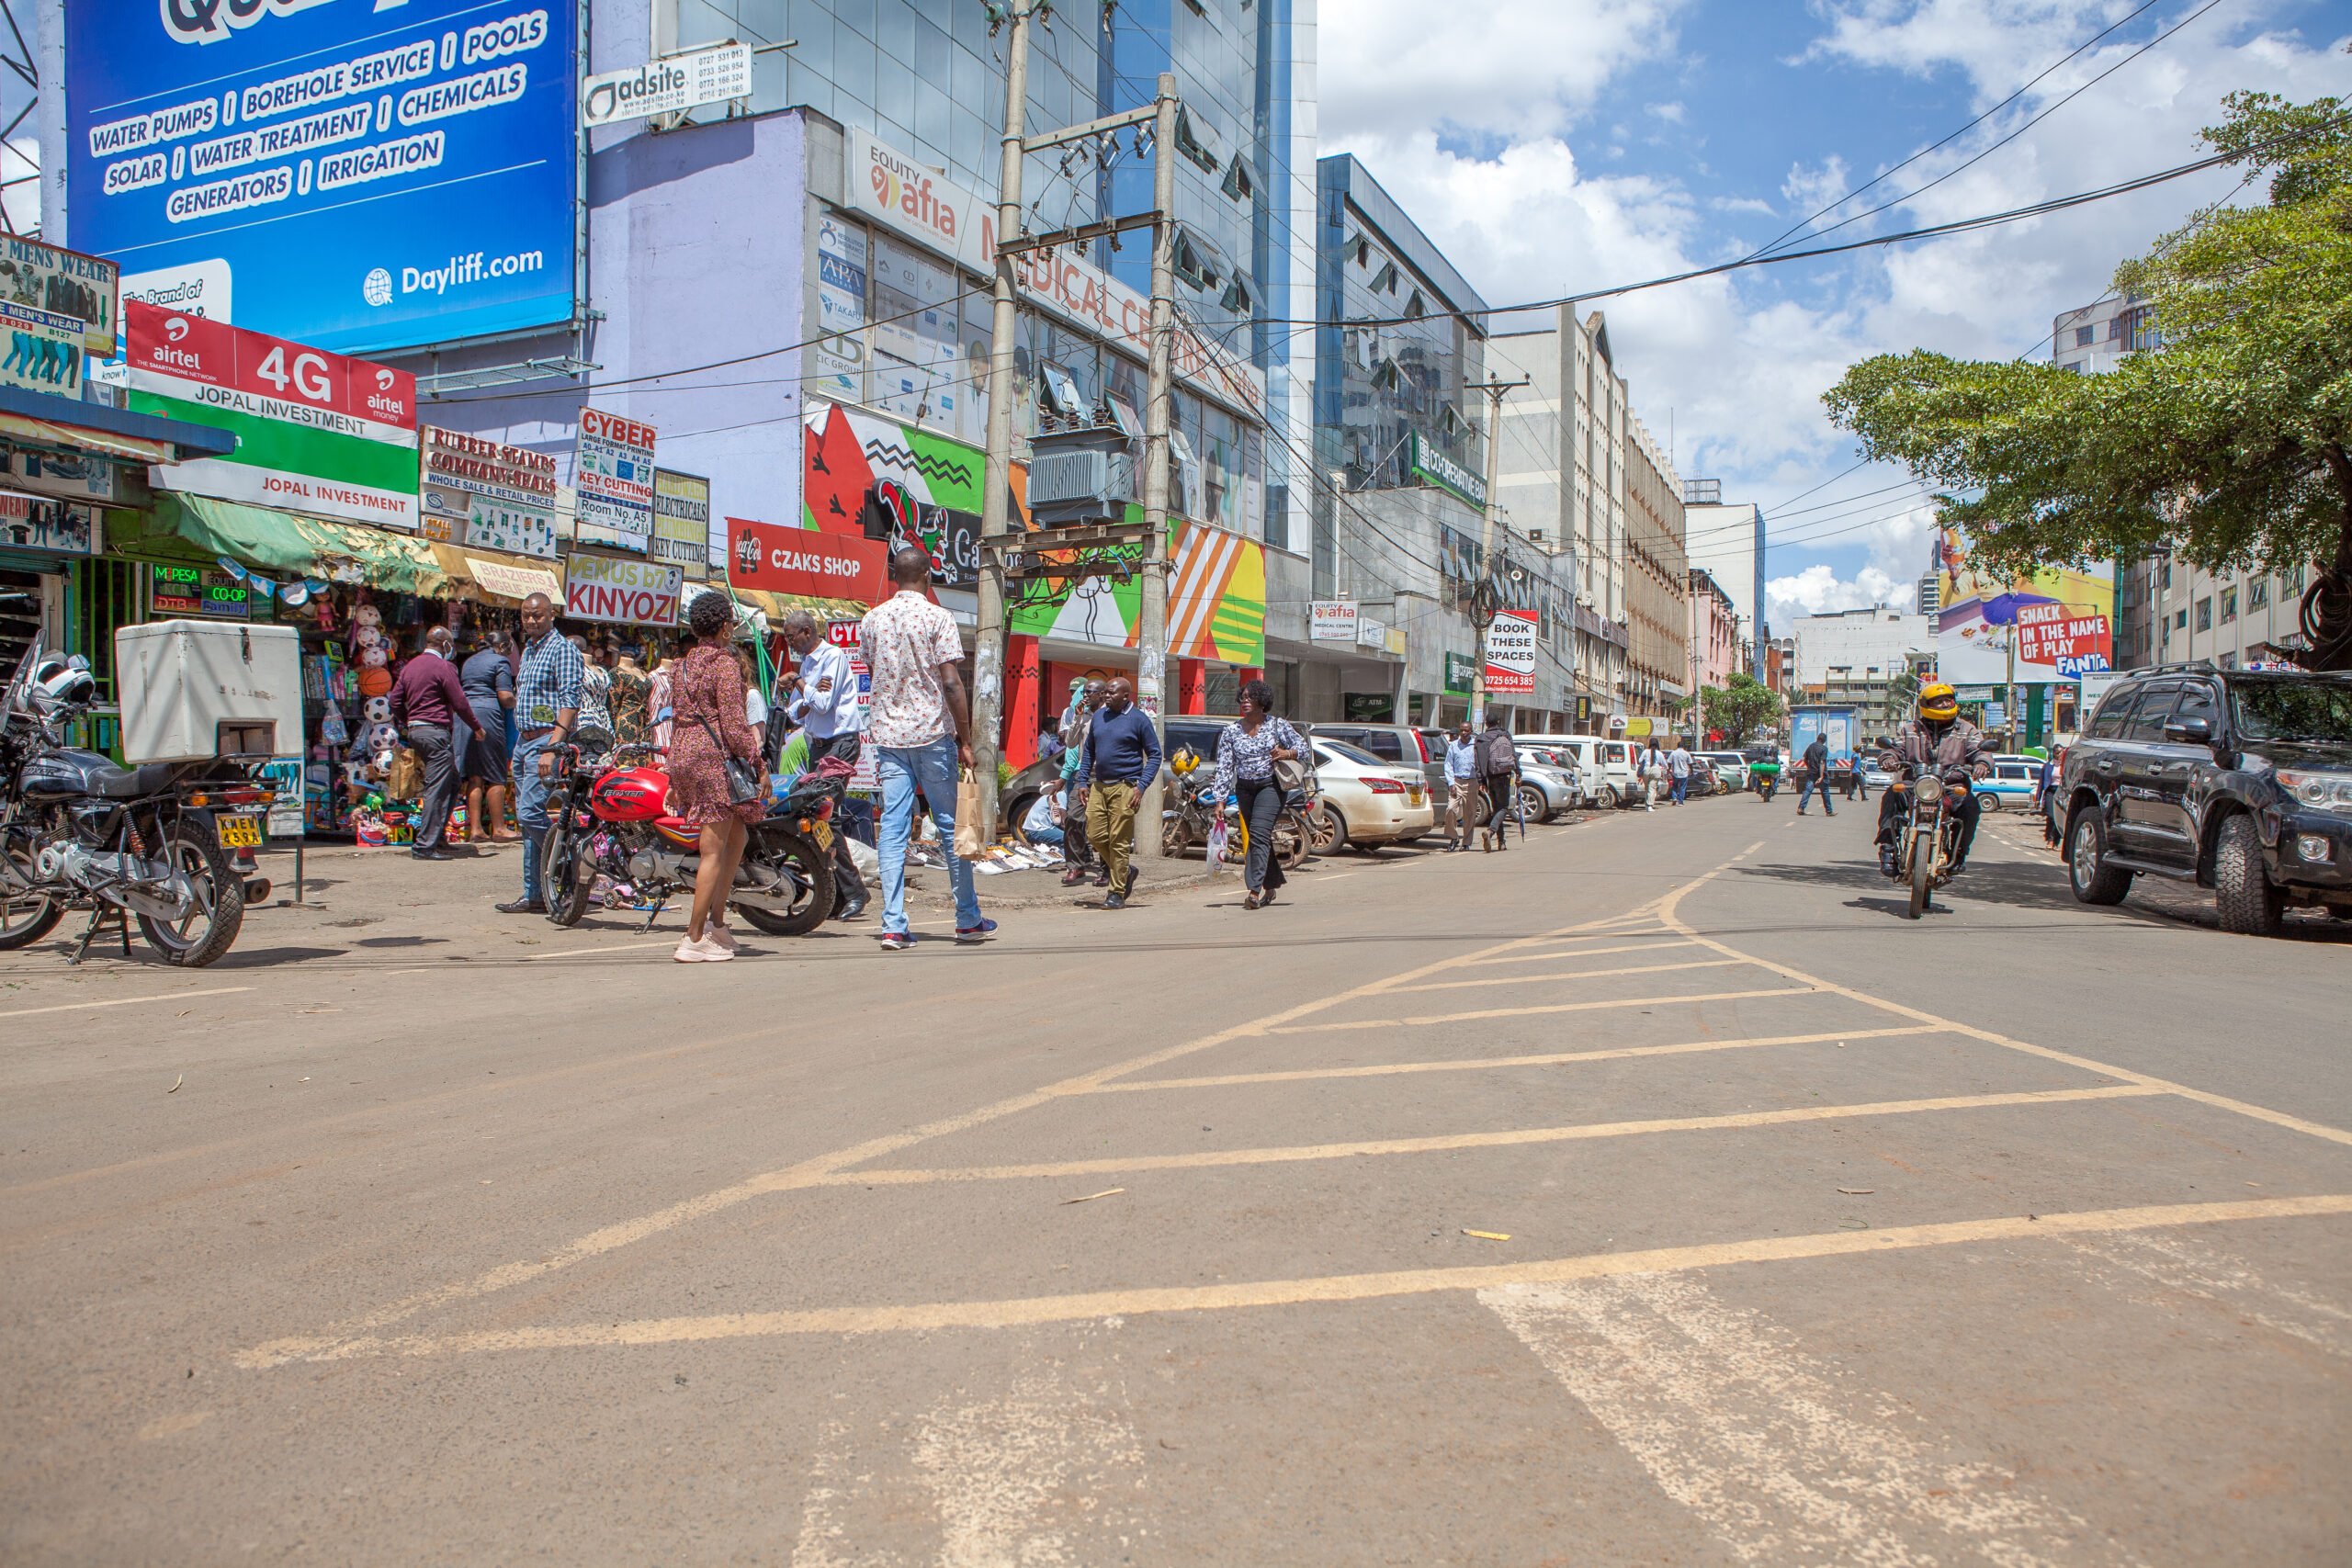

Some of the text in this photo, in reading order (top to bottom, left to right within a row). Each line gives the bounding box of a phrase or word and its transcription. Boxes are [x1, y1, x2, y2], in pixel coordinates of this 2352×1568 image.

[698, 49, 743, 65] 0727 531 013
[698, 61, 743, 77] 0733 526 954
[93, 17, 541, 152] WATER PUMPS BOREHOLE SERVICE POOLS
[618, 63, 685, 101] adsite
[698, 73, 743, 88] 0772 166 324
[108, 70, 521, 188] SOLAR WATER TREATMENT CHEMICALS
[171, 137, 440, 216] GENERATORS IRRIGATION
[870, 145, 921, 186] EQUITY
[901, 178, 956, 239] afia
[9, 240, 54, 269] MENS
[60, 253, 109, 284] WEAR
[401, 250, 543, 295] Dayliff.com
[147, 282, 186, 305] Brand
[187, 278, 204, 299] of
[9, 305, 45, 322] MEN'S
[48, 315, 81, 332] WEAR
[834, 302, 864, 321] TAKAFUL
[49, 328, 71, 340] B127
[102, 368, 121, 380] know
[149, 362, 188, 376] SMARTPHONE
[189, 371, 218, 382] NETWORK
[816, 354, 863, 376] CIC GROUP
[153, 344, 404, 415] airtel 4G airtel
[195, 386, 367, 434] JOPAL INVESTMENT
[373, 410, 400, 423] money
[582, 411, 656, 450] CYBER
[435, 428, 557, 473] RUBBER STAMPS
[581, 434, 655, 458] LARGE FORMAT PRINTING
[582, 442, 592, 450] A0
[594, 446, 603, 454] A1
[618, 451, 627, 459] A3
[631, 455, 640, 463] A4
[643, 457, 651, 466] A5
[431, 451, 557, 493] COMPANY SEALS
[579, 470, 653, 498] KEY CUTTING
[1430, 449, 1475, 496] CO-OPERATIVE
[262, 478, 406, 513] JOPAL INVESTMENT
[428, 473, 555, 507] WHOLE SALE & RETAIL PRICES
[582, 484, 648, 504] CAR KEY PROGRAMMING
[0, 495, 28, 517] WEAR
[582, 500, 647, 524] Room No. A5
[656, 494, 707, 523] ELECTRICALS
[655, 515, 706, 545] PLUMBINGS
[654, 537, 705, 563] KEY CUTTING
[771, 548, 861, 577] CZAKS SHOP
[480, 563, 546, 586] BRAZIERS
[568, 556, 638, 586] VENUS
[644, 565, 665, 590] b7
[158, 596, 247, 614] DTB Family
[164, 583, 246, 602] KCB CO-OP
[568, 582, 676, 624] KINYOZI
[1328, 604, 1355, 617] afia
[2019, 604, 2061, 626] SNACK
[1494, 624, 1530, 633] BOOK
[2021, 618, 2105, 644] IN THE NAME
[1491, 637, 1532, 647] THESE
[2023, 638, 2075, 660] OF PLAY
[1487, 651, 1534, 660] SPACES
[2056, 653, 2109, 674] FANTA
[1485, 675, 1533, 686] 0725 654 385
[604, 789, 646, 797] BOXER
